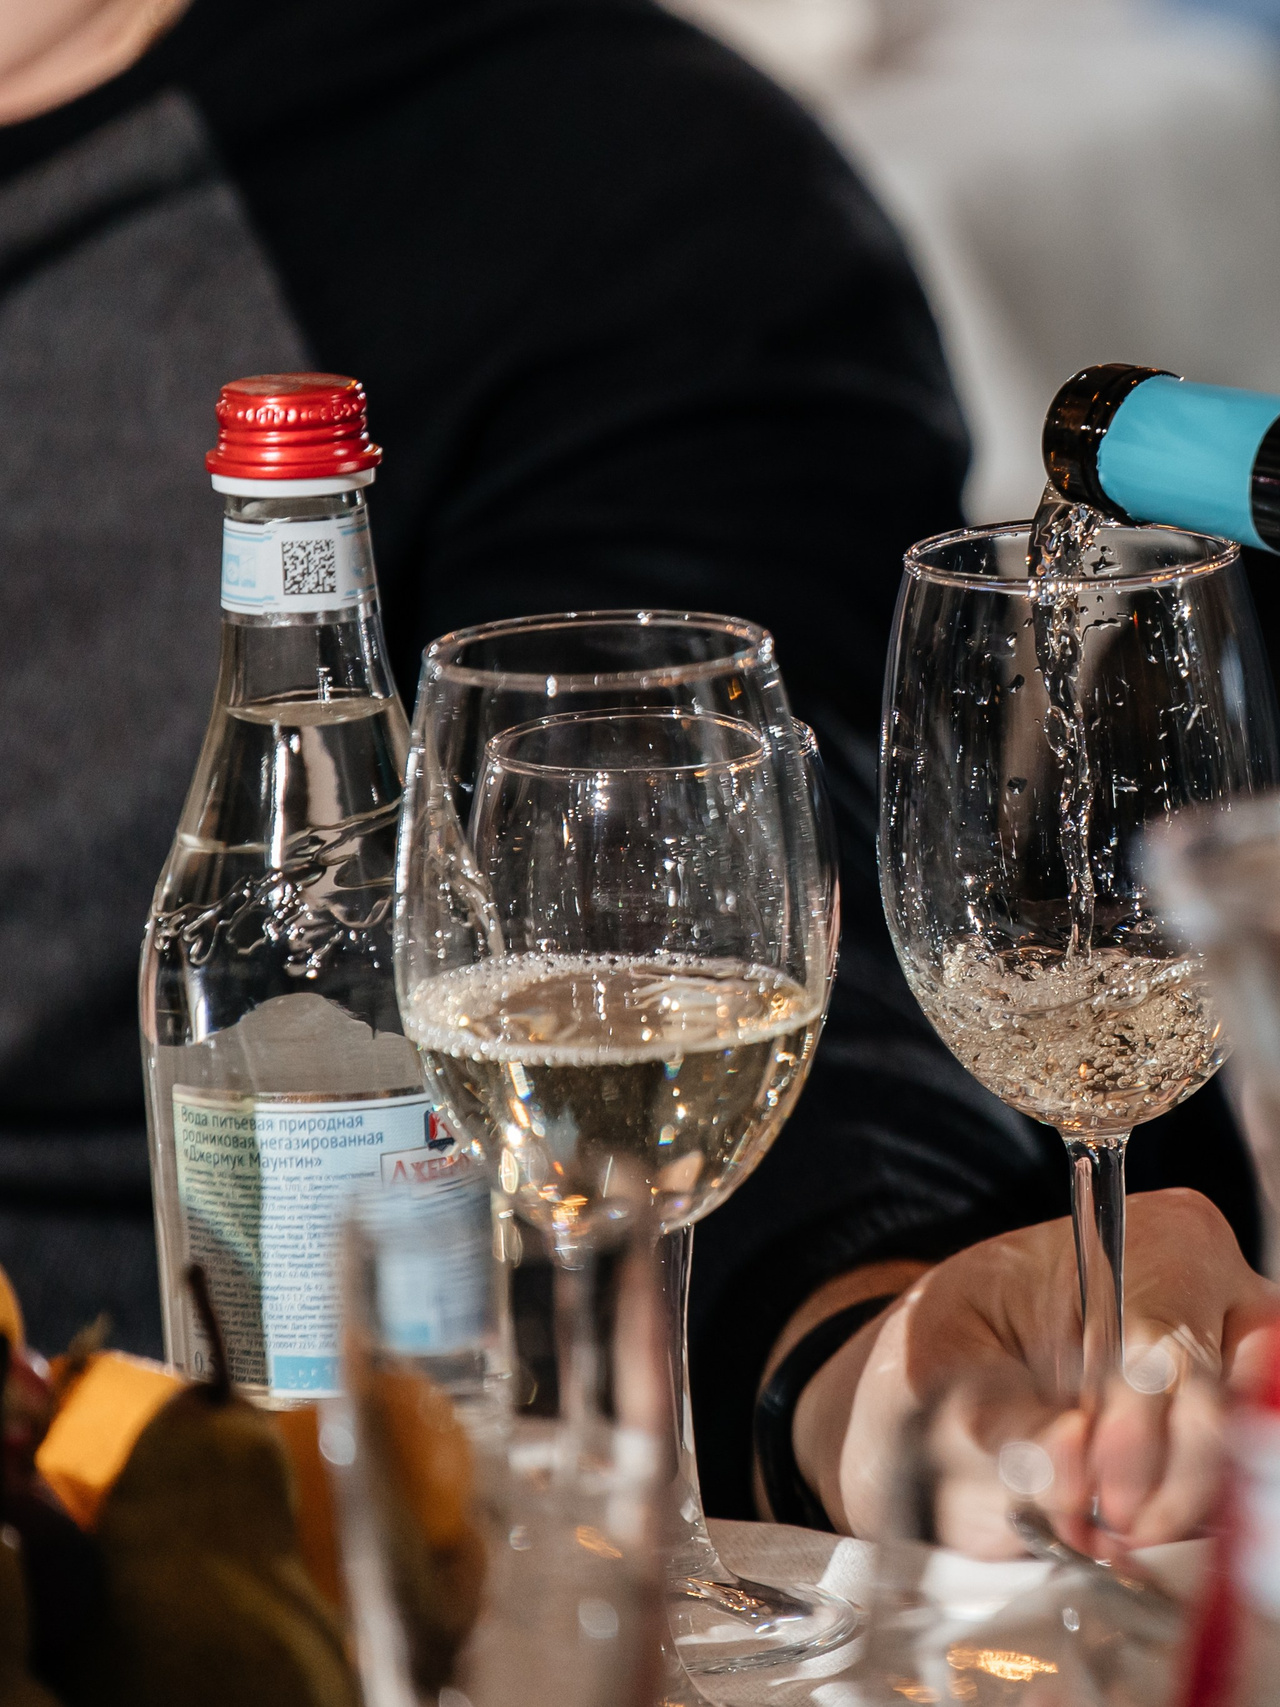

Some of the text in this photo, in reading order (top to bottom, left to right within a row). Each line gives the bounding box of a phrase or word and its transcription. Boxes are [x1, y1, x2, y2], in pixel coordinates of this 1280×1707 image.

[180, 1106, 364, 1134] Вода питьевая природная
[182, 1128, 384, 1152] родниковая негазированная
[184, 1145, 322, 1172] «Джермук Маунтин»
